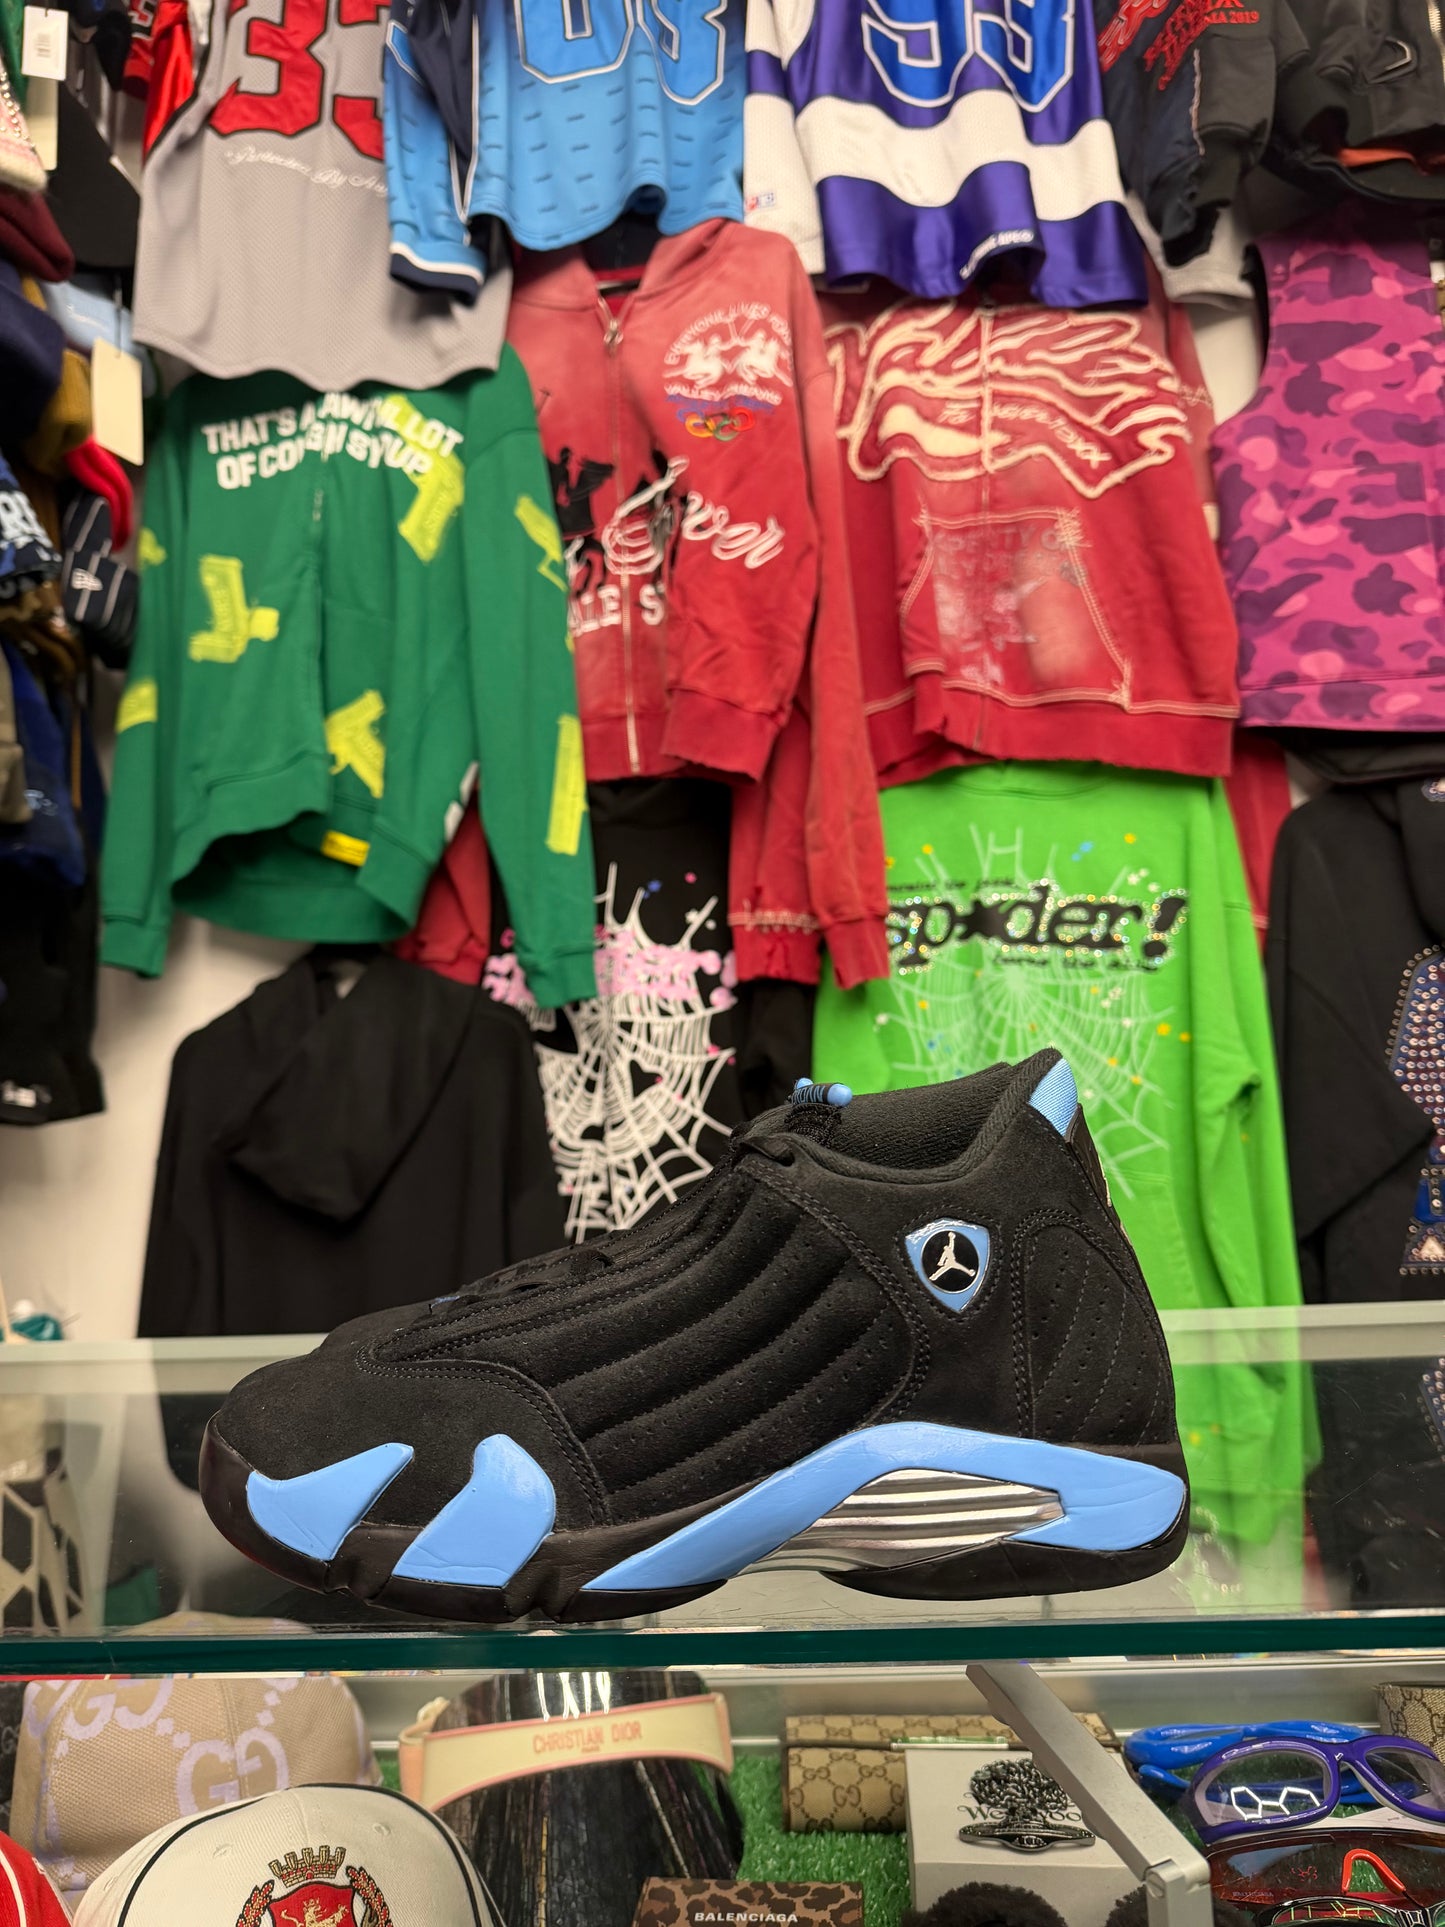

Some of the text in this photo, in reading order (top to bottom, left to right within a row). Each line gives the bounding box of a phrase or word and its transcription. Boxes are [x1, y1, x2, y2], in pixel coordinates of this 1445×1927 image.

[201, 406, 297, 454] THAT'S
[401, 411, 464, 457] LOT
[215, 452, 257, 490] OF
[532, 1720, 643, 1755] CHRISTIAN DIOR
[694, 1912, 798, 1923] BALENCIAGA
